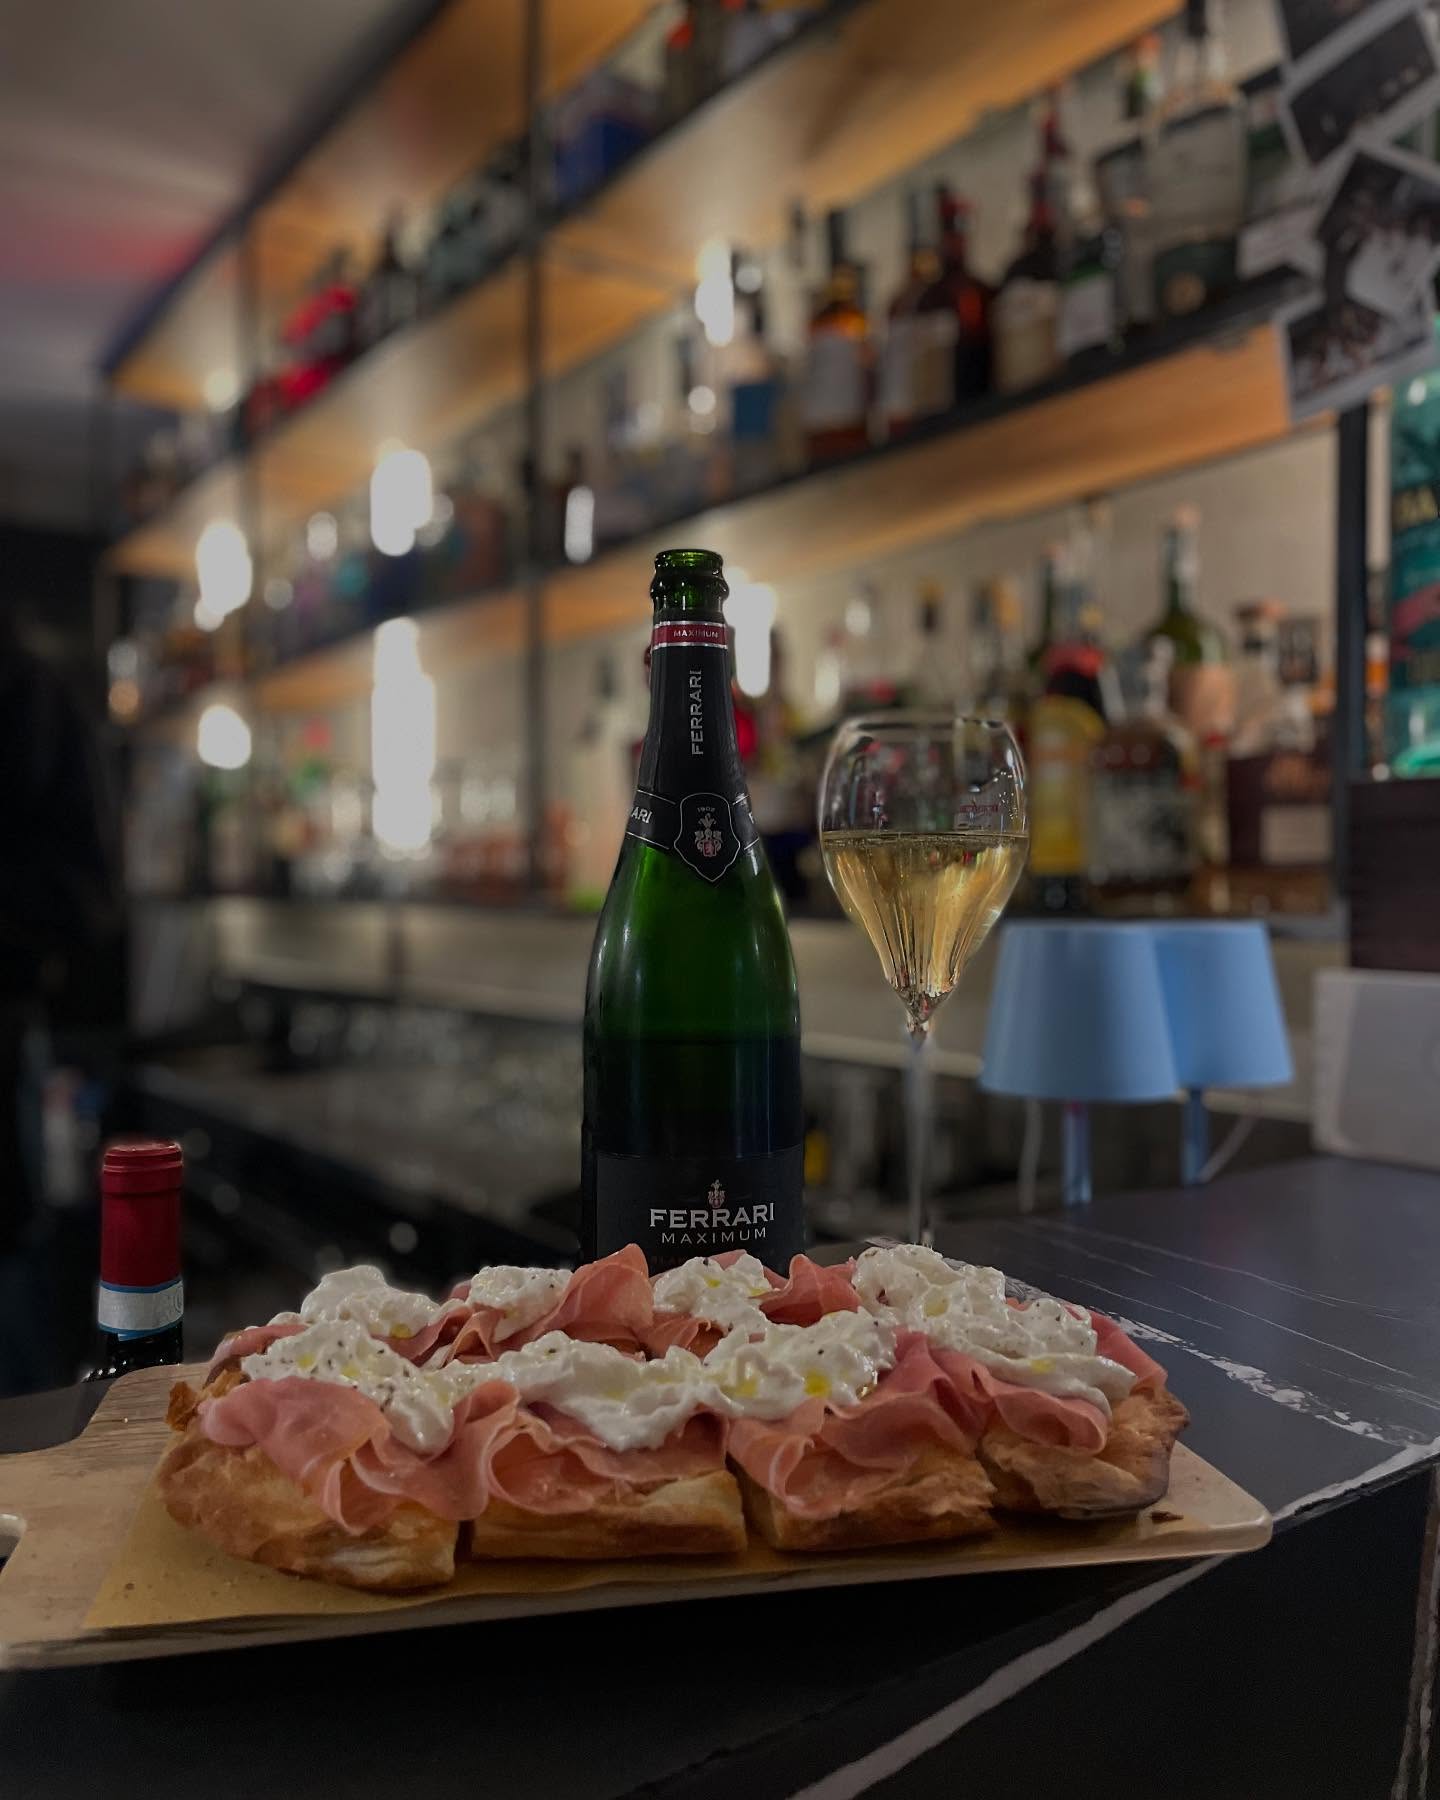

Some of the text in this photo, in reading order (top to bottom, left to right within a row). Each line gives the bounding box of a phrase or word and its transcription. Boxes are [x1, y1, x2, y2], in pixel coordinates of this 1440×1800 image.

[673, 629, 719, 639] MAXIMUM
[689, 670, 704, 755] FERRARI
[649, 1202, 775, 1229] FERRARI
[661, 1226, 767, 1245] MAXIMUM
